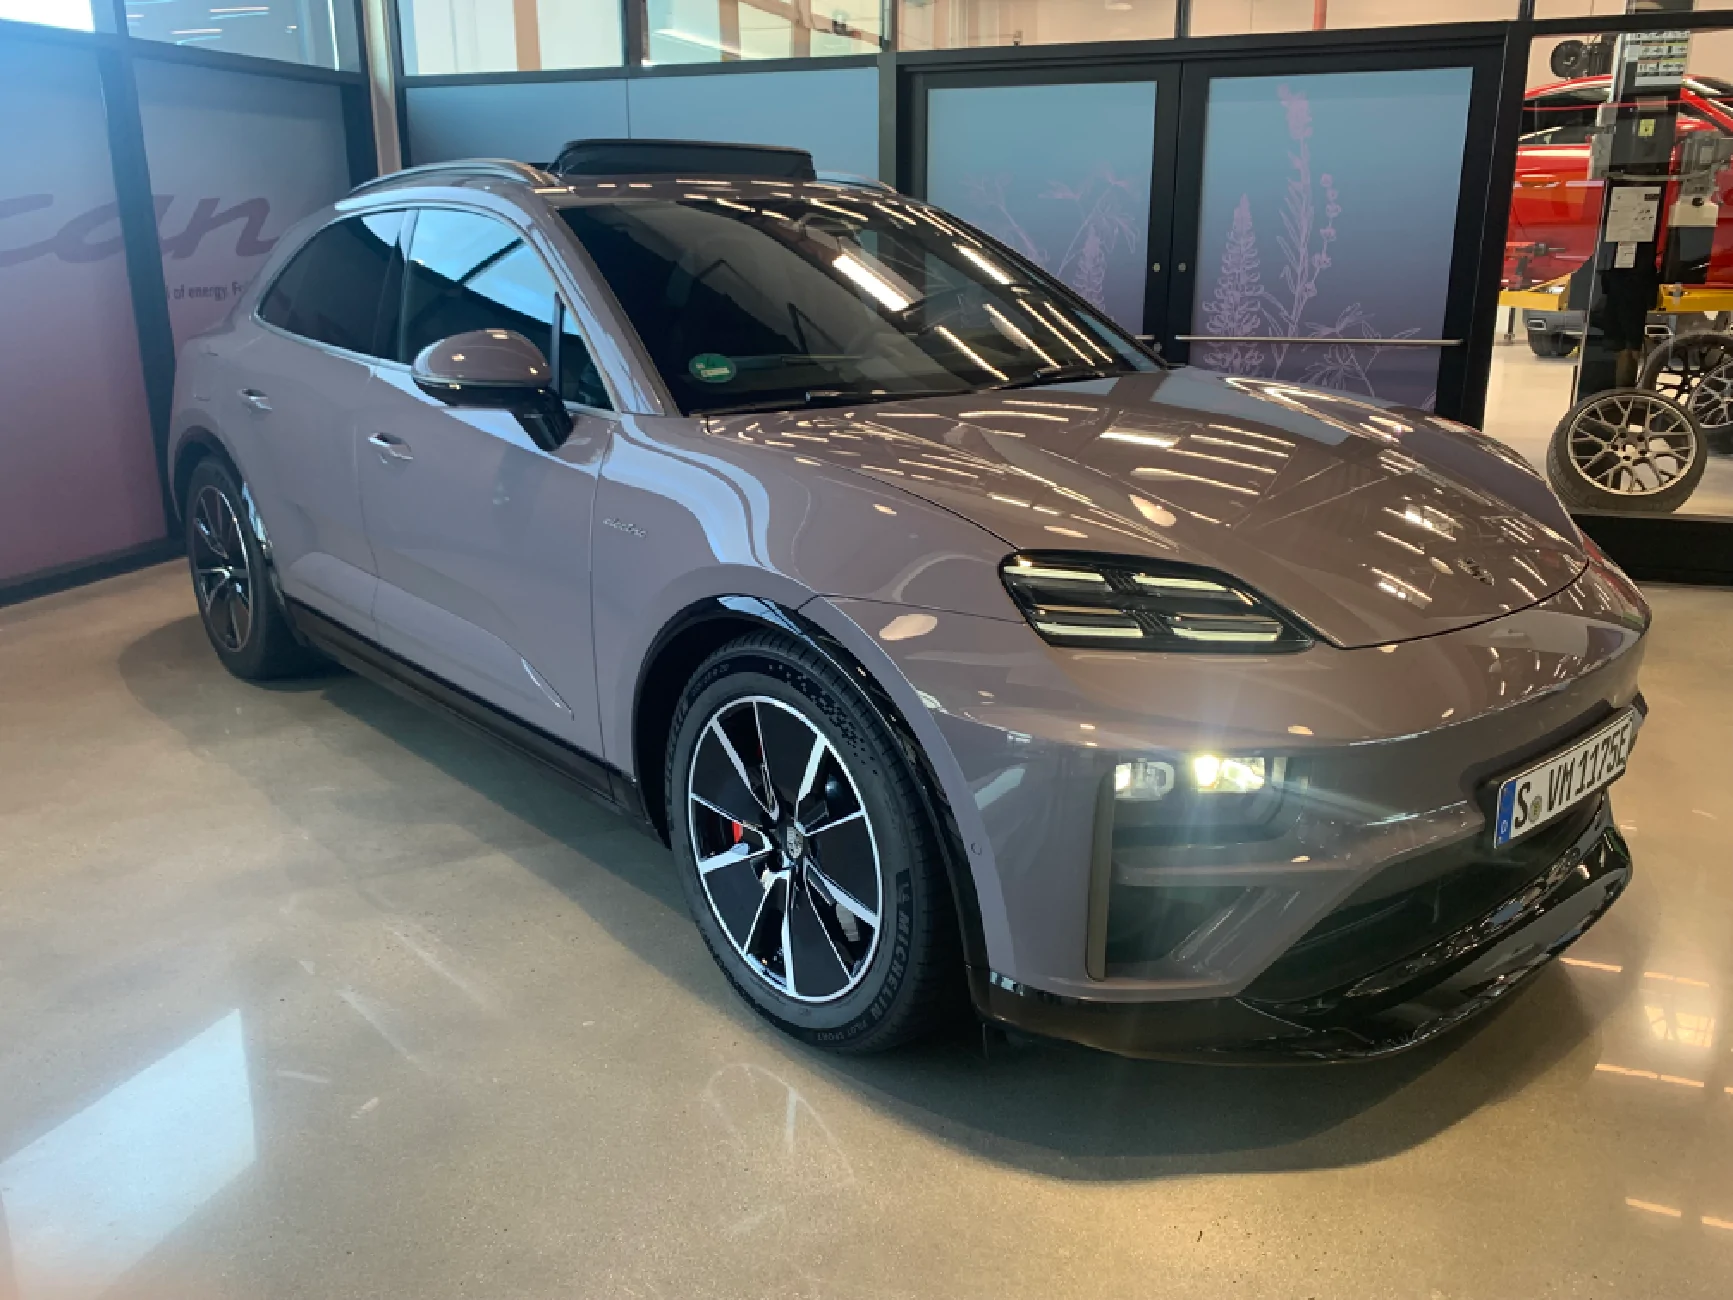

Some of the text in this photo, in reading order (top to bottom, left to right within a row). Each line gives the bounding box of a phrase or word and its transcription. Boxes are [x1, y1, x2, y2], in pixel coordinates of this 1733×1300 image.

[174, 284, 185, 299] of
[1514, 781, 1531, 829] S
[1548, 757, 1576, 812] VM
[870, 909, 911, 1021] MICHELIN
